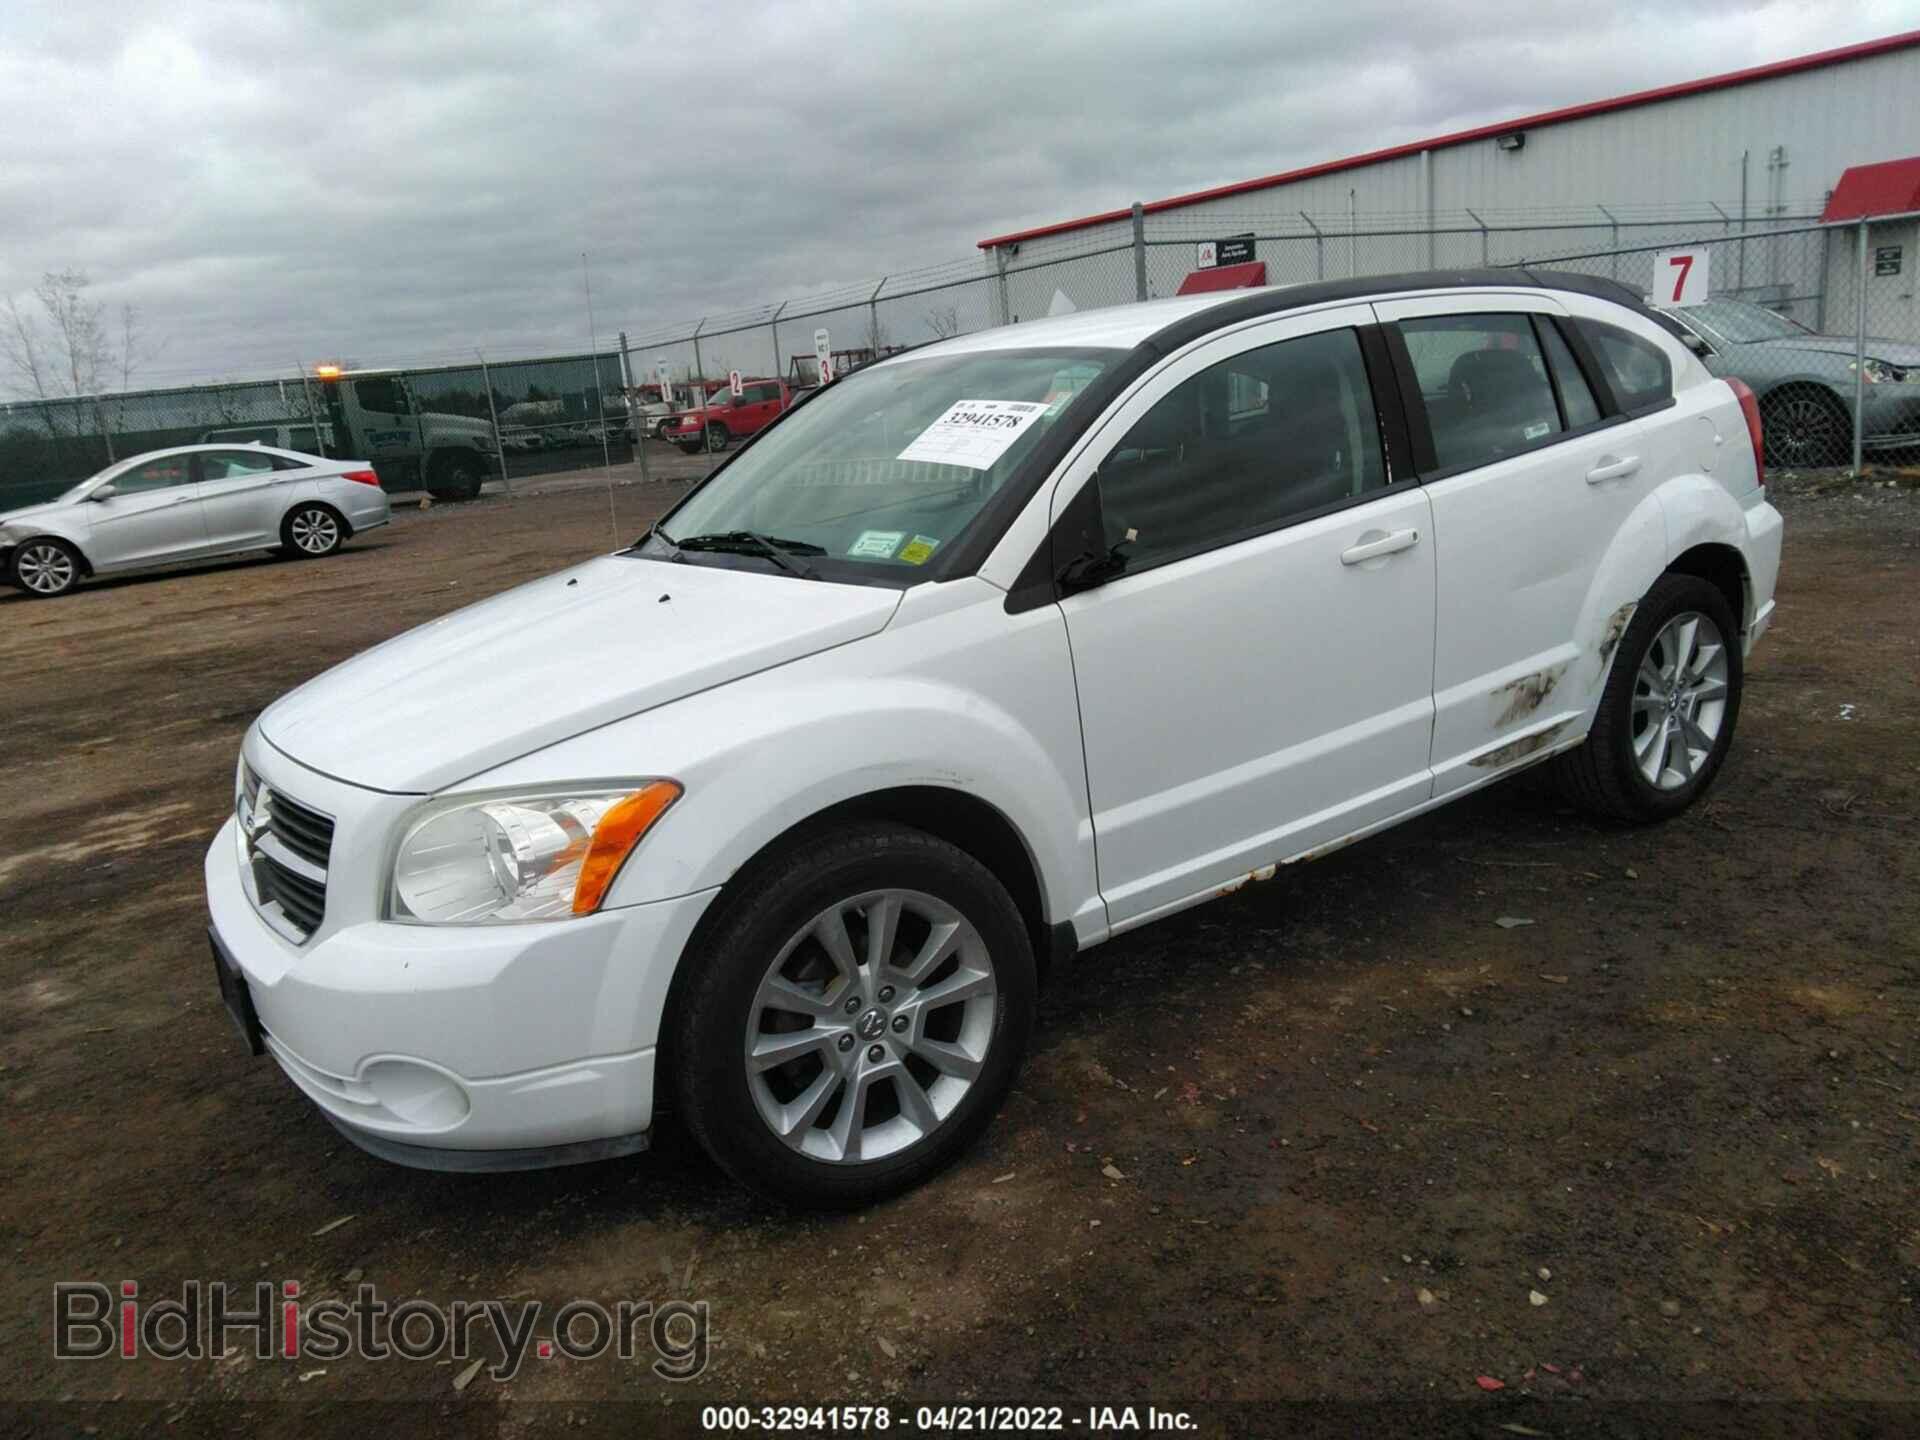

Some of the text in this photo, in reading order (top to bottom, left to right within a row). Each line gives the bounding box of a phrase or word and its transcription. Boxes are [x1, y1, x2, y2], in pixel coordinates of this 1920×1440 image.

[1670, 255, 1693, 301] 7
[732, 372, 741, 393] 2
[820, 360, 830, 384] 3
[944, 412, 1023, 428] 32941578
